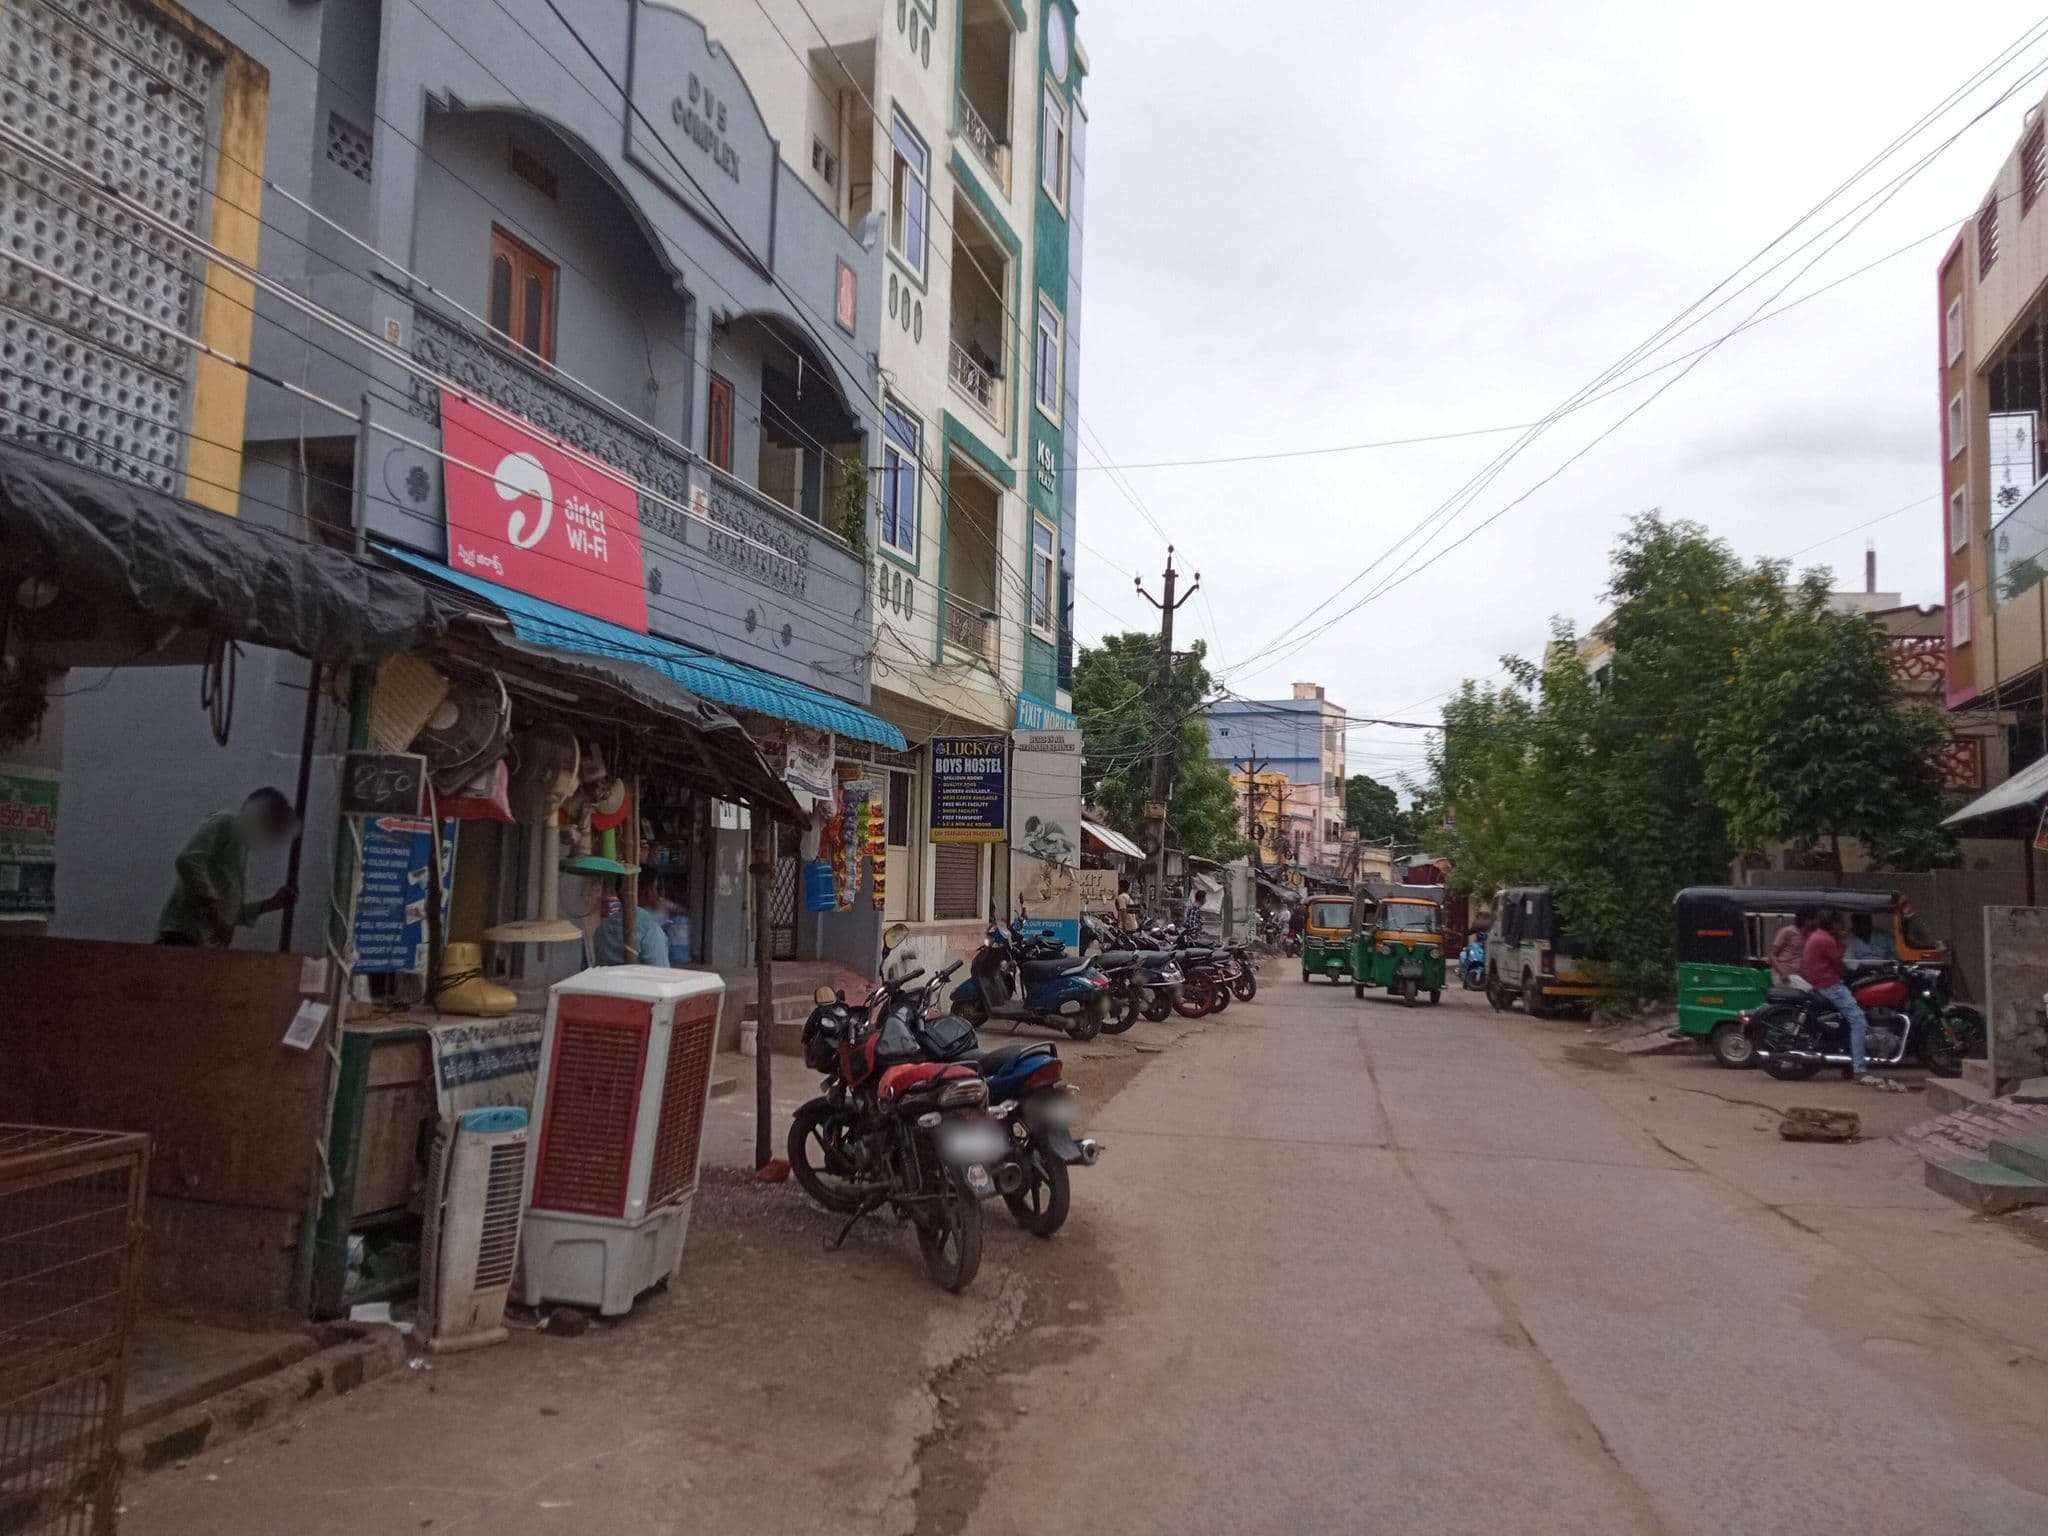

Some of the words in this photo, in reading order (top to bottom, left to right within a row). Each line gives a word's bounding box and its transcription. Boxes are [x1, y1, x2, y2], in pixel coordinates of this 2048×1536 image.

[671, 96, 740, 184] COMPLEX
[1036, 440, 1056, 478] KSL
[564, 495, 606, 536] airtel
[566, 523, 608, 562] Wi-Fi
[1019, 699, 1042, 729] FIXIT
[935, 758, 963, 774] BOYS
[964, 758, 1003, 774] HOSTEL
[945, 742, 992, 756] LUCKY
